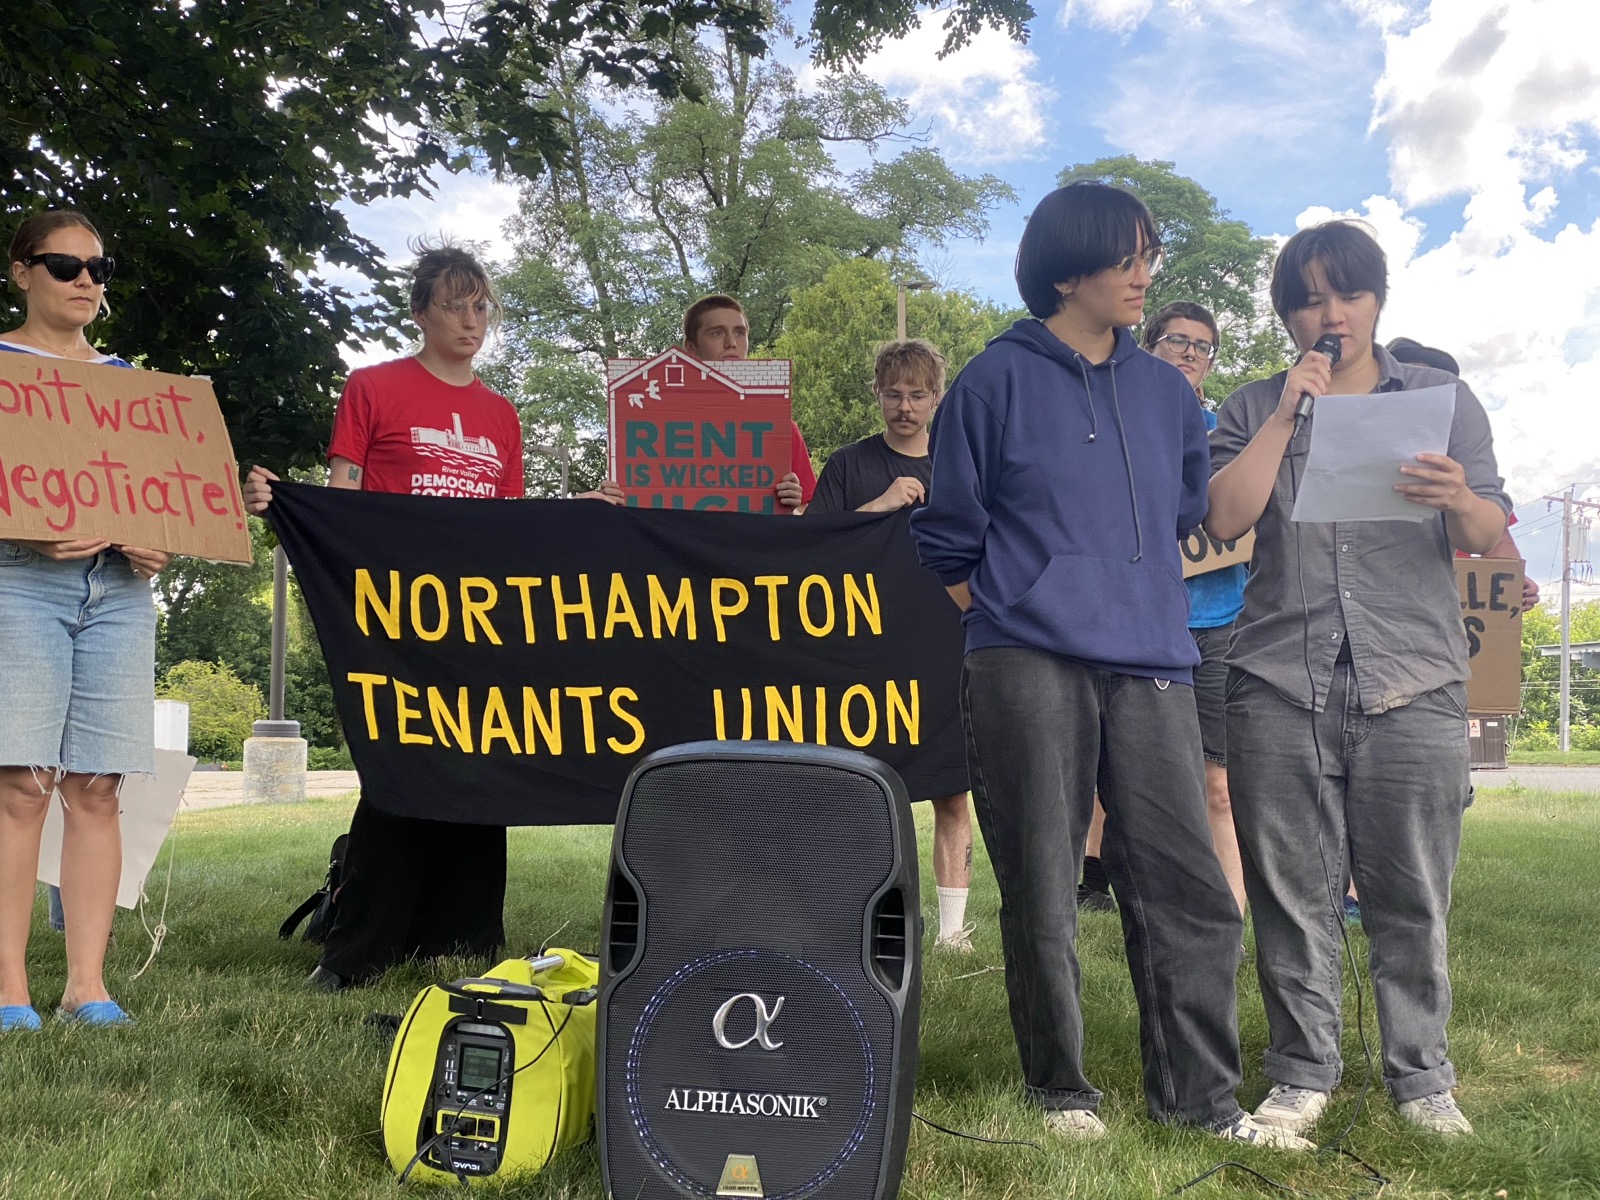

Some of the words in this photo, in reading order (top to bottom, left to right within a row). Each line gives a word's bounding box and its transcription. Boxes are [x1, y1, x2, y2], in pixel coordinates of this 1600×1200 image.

[0, 367, 81, 425] on't
[85, 385, 205, 443] wait,
[625, 420, 774, 459] RENT
[411, 474, 496, 497] DEMOCRATI
[442, 465, 459, 476] River
[460, 469, 479, 480] Valley
[625, 463, 650, 487] IS
[659, 463, 775, 488] WICKED
[355, 568, 882, 645] NORTHAMPTON
[347, 672, 646, 755] TENANTS
[713, 680, 920, 747] UNION
